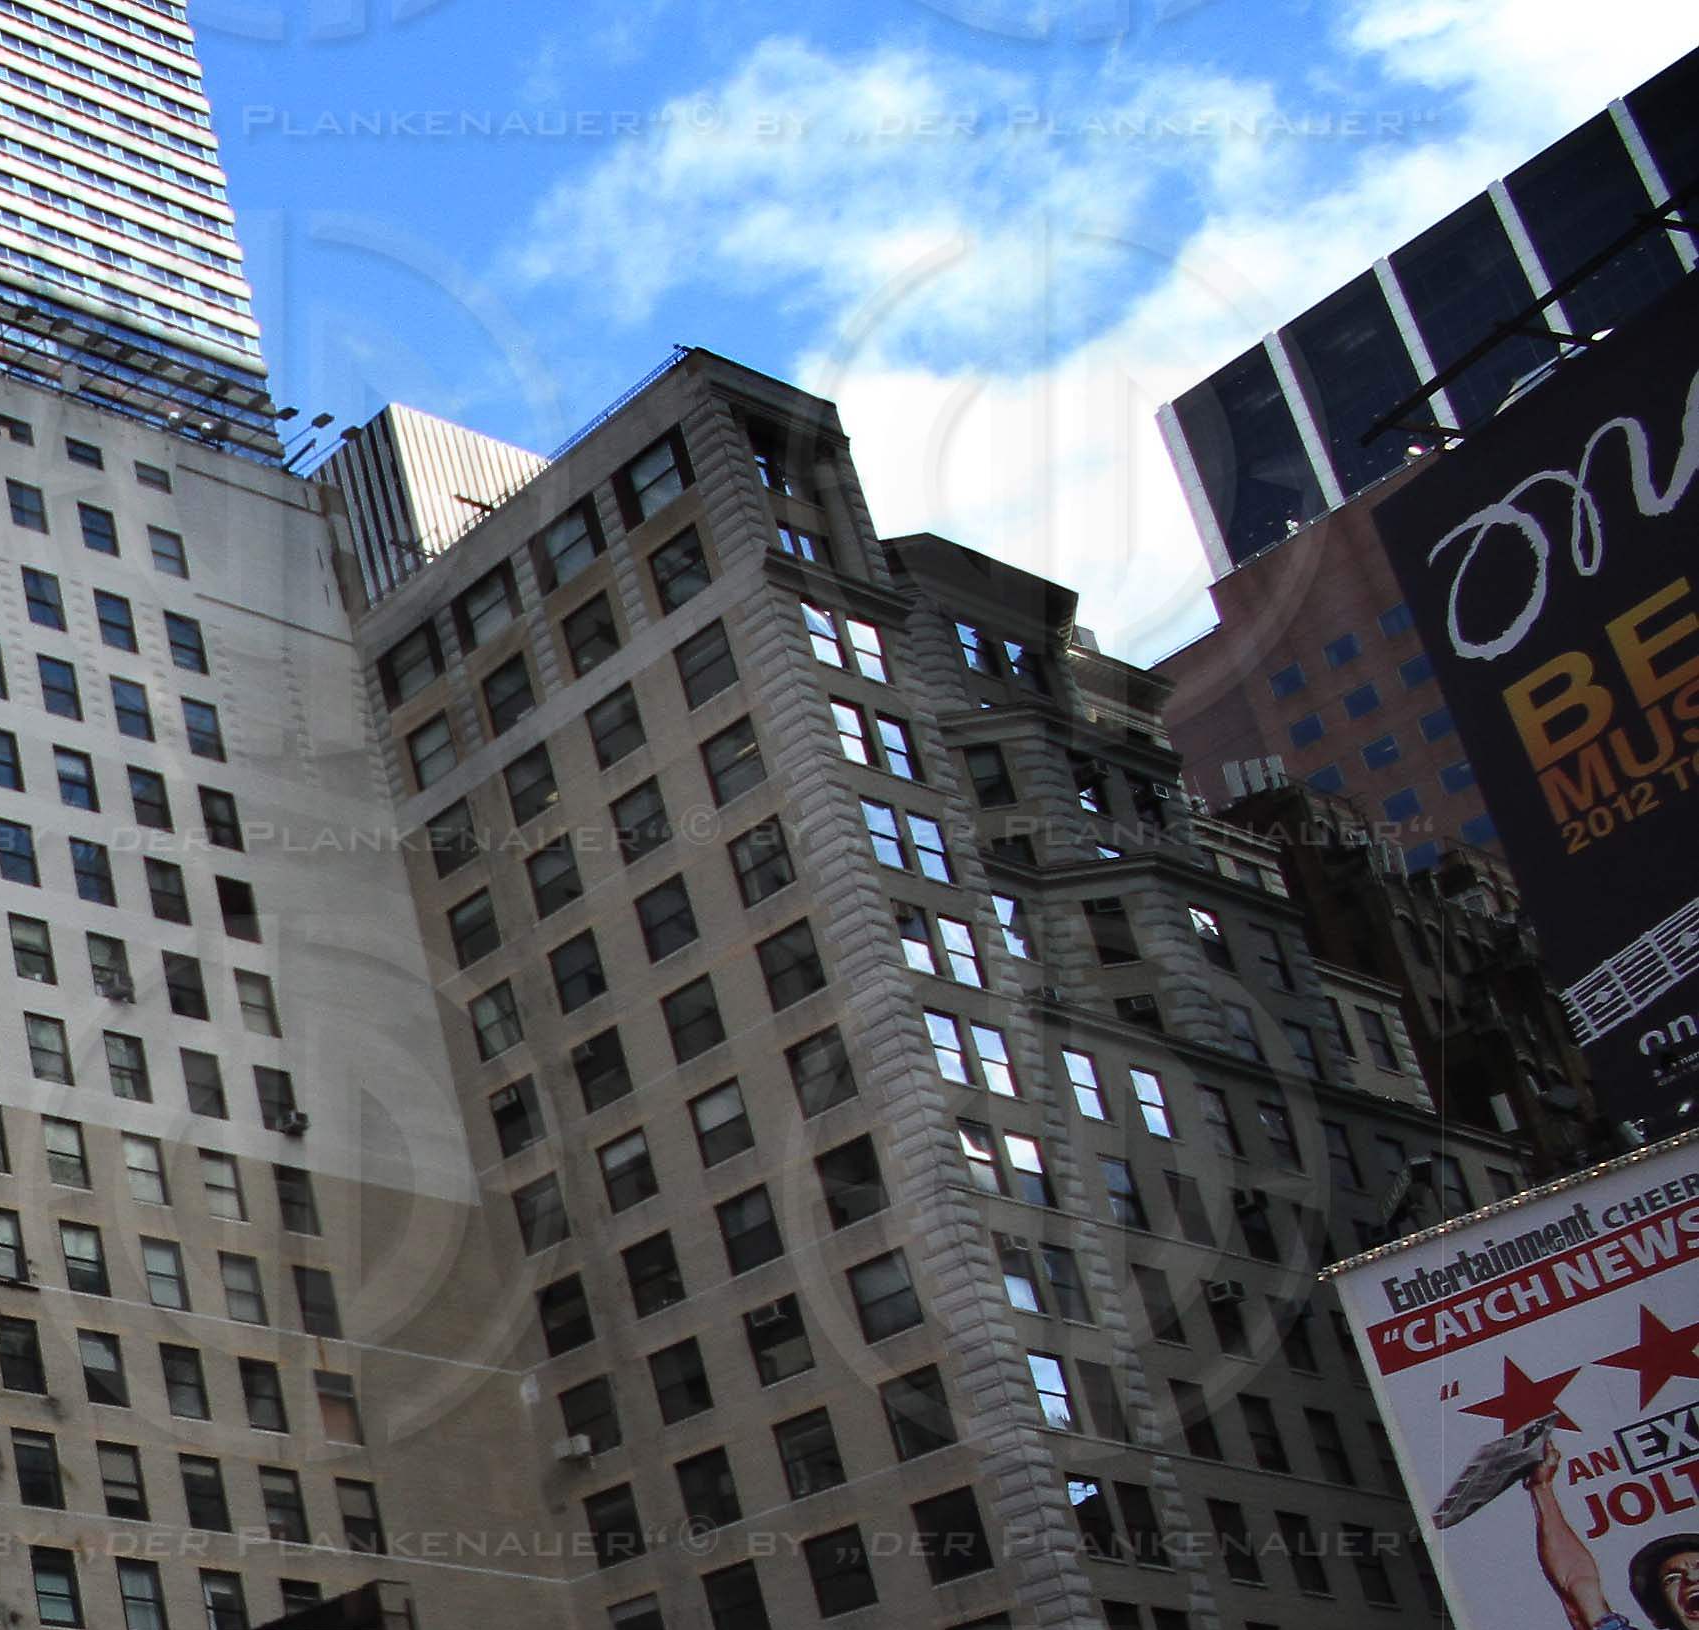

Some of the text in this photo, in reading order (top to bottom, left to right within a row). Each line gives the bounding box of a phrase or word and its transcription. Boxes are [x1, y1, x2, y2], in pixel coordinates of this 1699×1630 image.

[1560, 781, 1664, 856] 2012
[1381, 1202, 1599, 1315] Entertainment
[1567, 1445, 1623, 1486] AN
